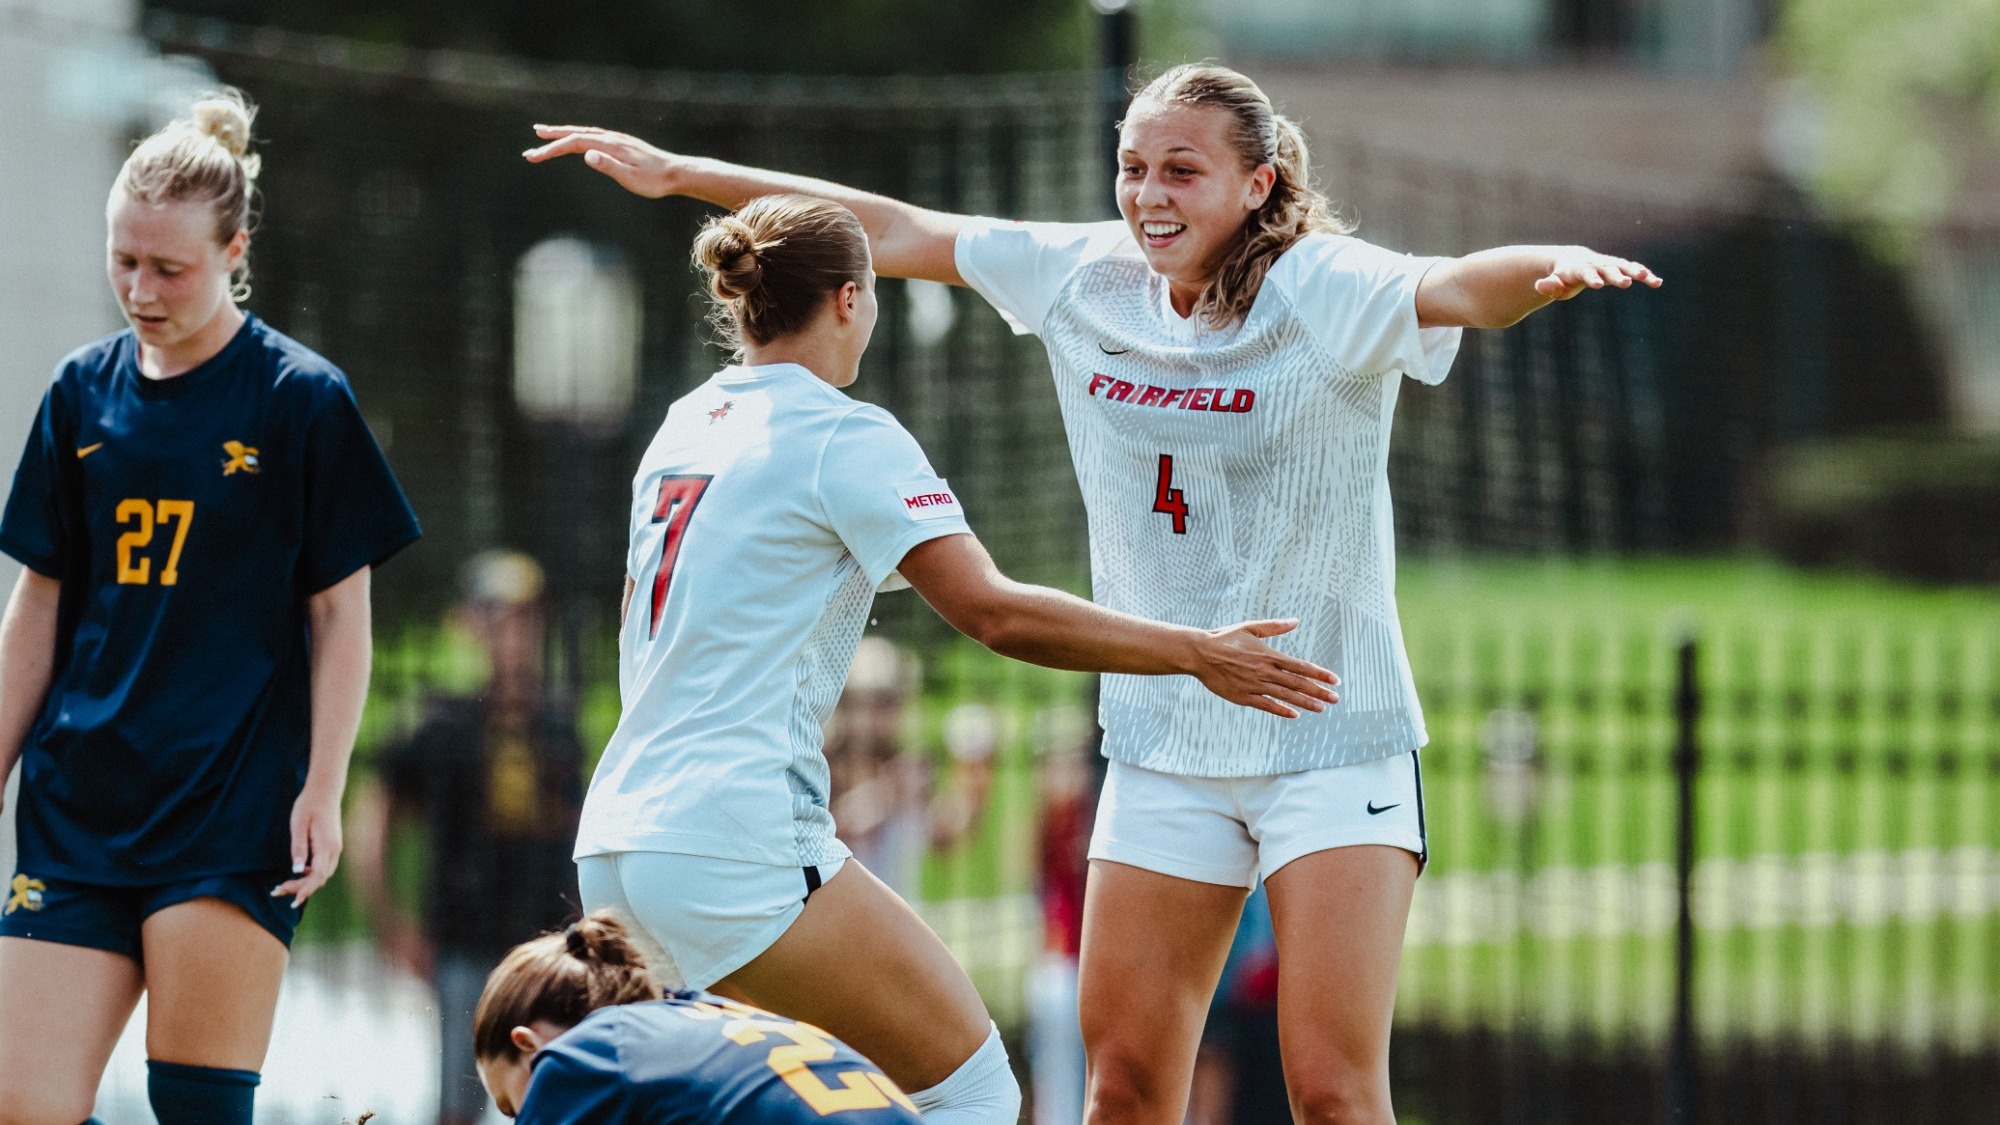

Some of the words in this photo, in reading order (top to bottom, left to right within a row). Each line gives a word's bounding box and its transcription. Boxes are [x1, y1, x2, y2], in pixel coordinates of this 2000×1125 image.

[1088, 373, 1256, 413] FAIRFIELD
[903, 493, 953, 509] METRO
[1152, 454, 1189, 535] 4
[116, 498, 195, 587] 27
[649, 474, 714, 641] 7
[721, 1018, 919, 1117] 2
